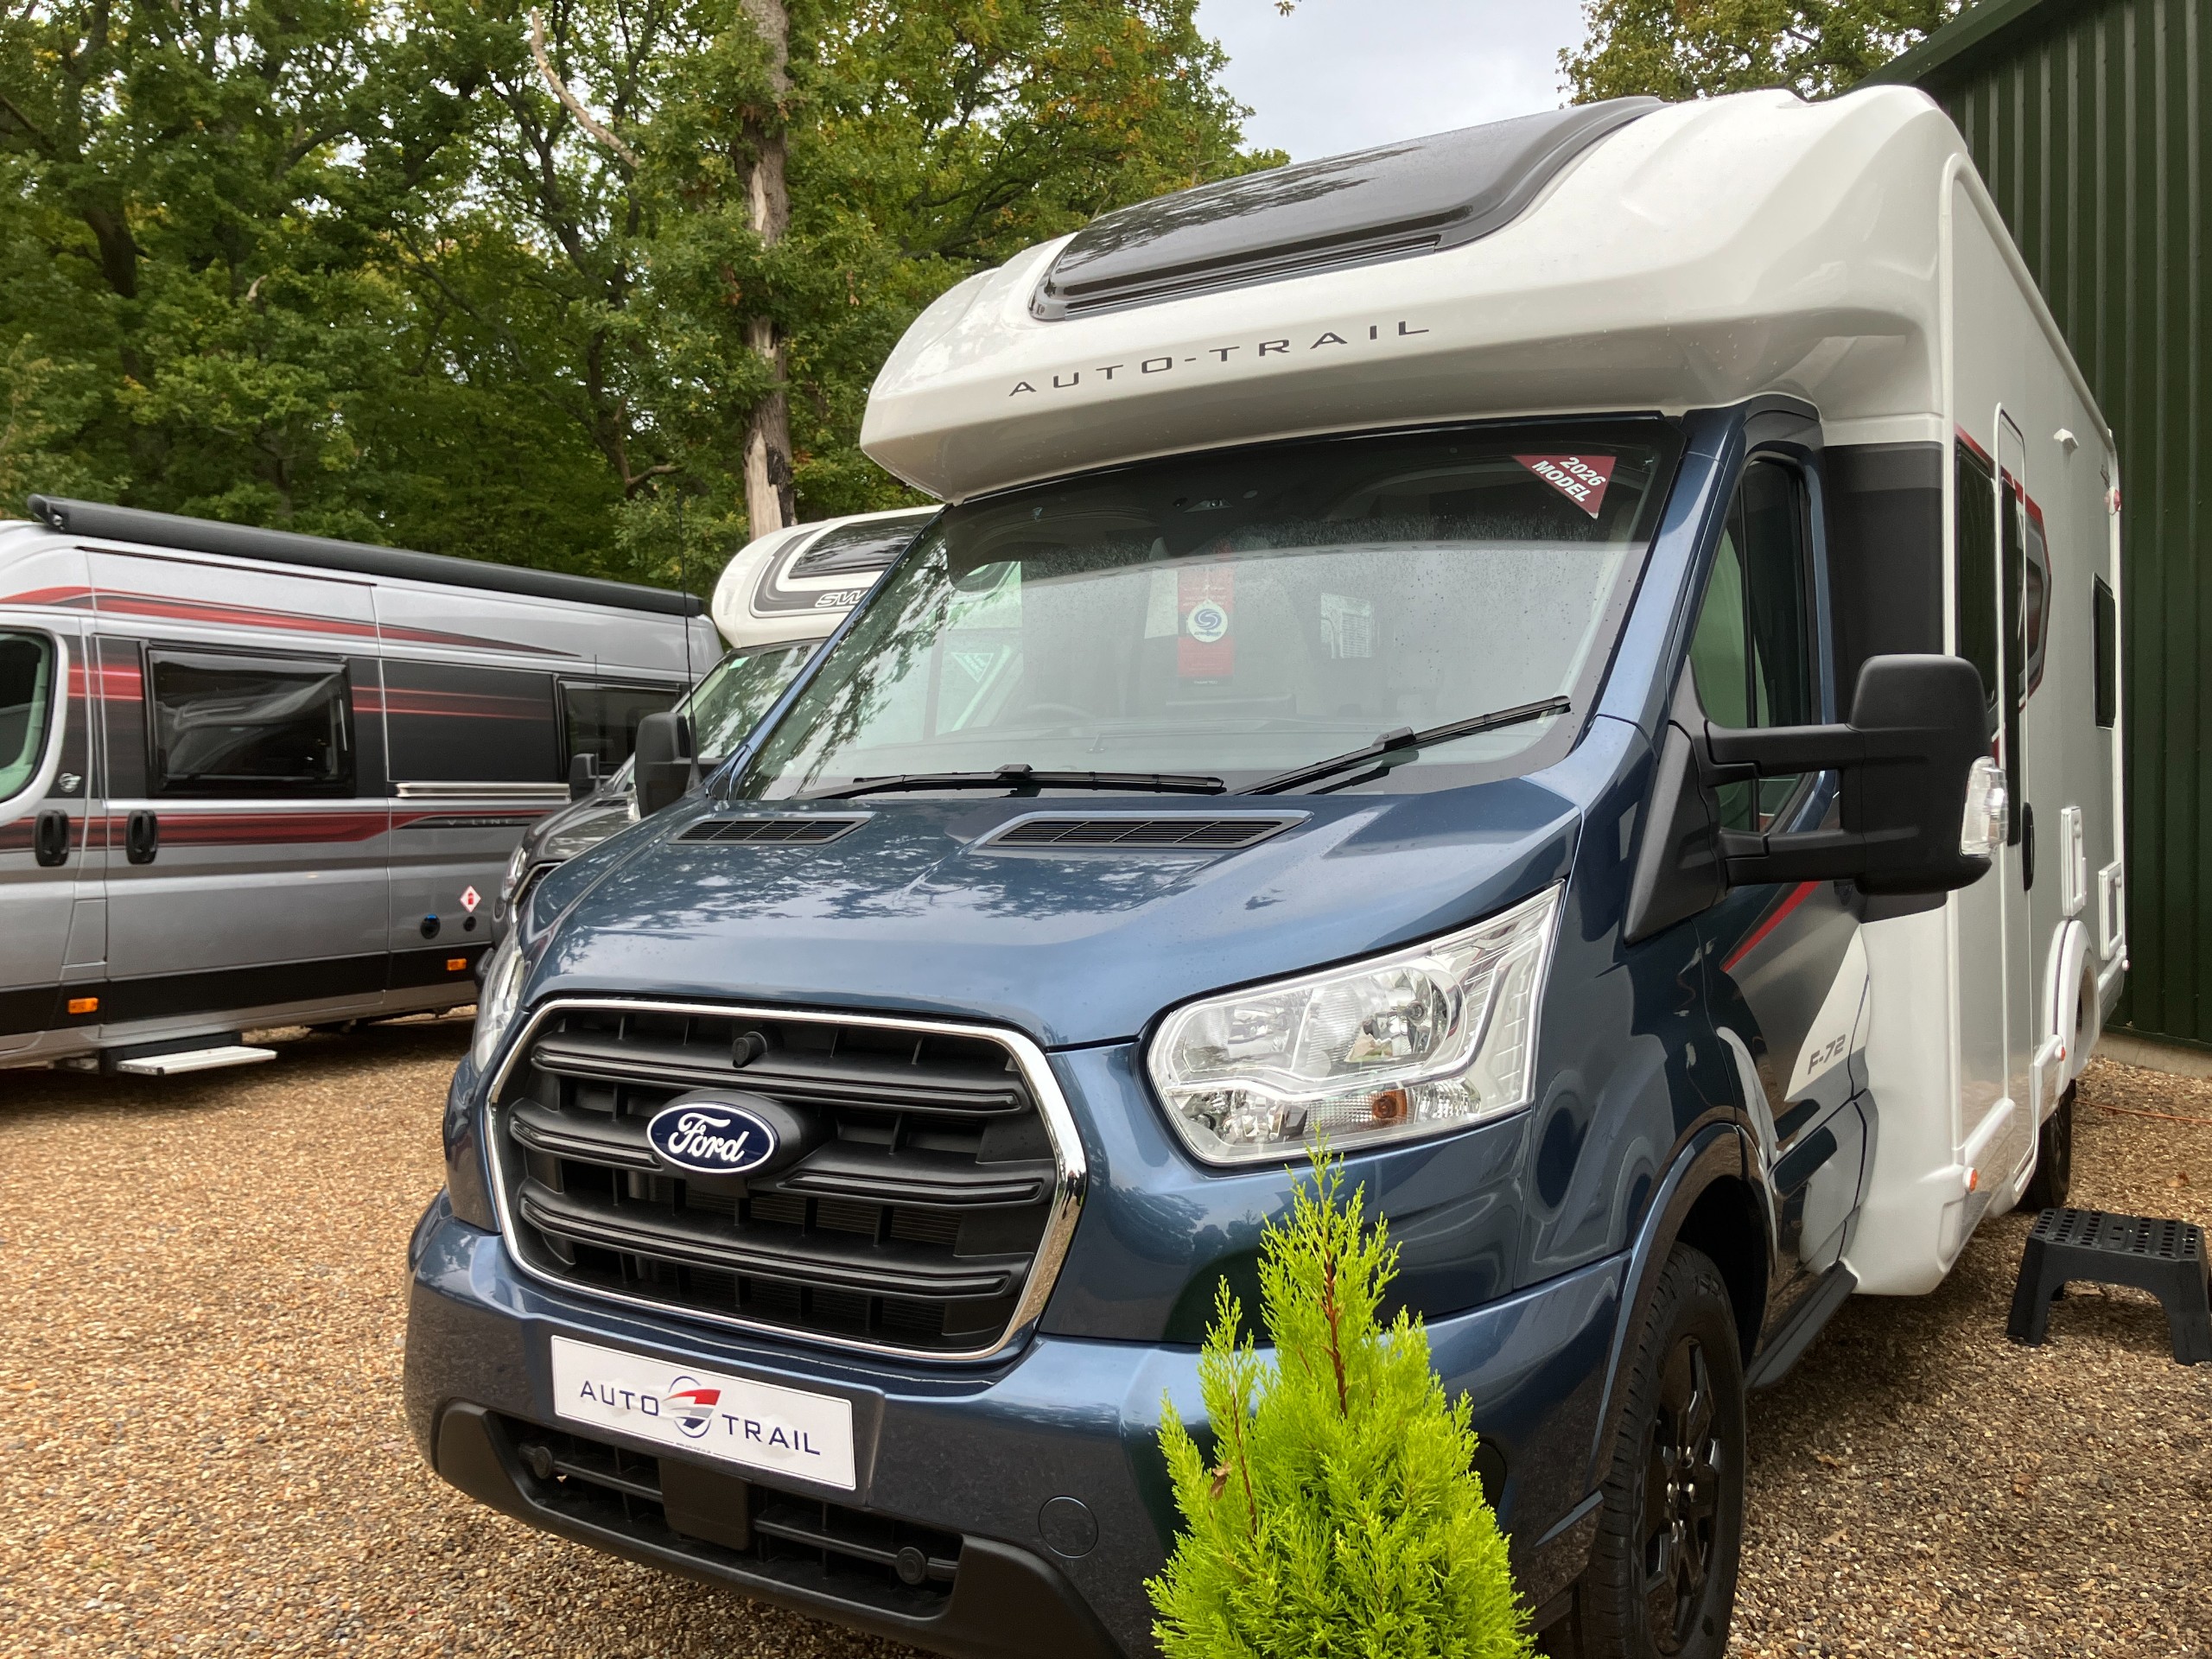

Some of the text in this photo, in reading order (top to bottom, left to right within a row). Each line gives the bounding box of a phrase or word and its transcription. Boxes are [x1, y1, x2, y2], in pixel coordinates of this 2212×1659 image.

[1008, 321, 1430, 397] AUTO-TRAIL
[1531, 460, 1592, 502] MODEL
[1560, 456, 1606, 486] 2026
[1807, 1033, 1847, 1076] F-72
[668, 1112, 750, 1162] Ford
[580, 1380, 821, 1456] AUTO TRAIL
